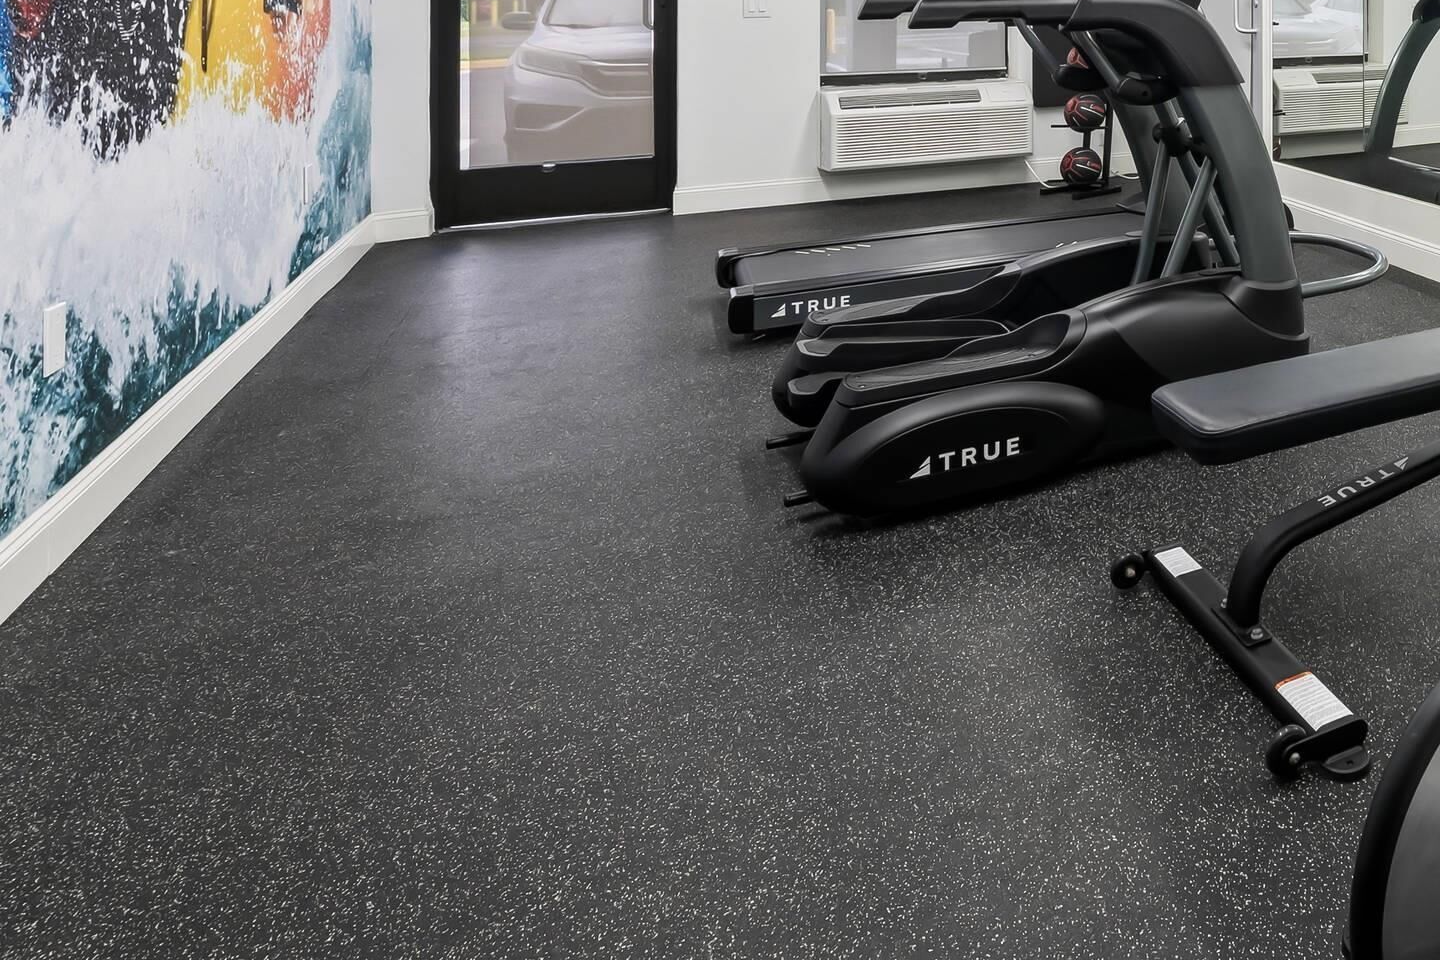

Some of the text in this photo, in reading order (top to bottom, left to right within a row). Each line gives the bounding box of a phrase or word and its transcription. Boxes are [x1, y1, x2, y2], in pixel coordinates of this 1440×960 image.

[791, 295, 851, 314] TRUE
[938, 436, 1020, 471] TRUE
[1317, 469, 1395, 507] TRUE
